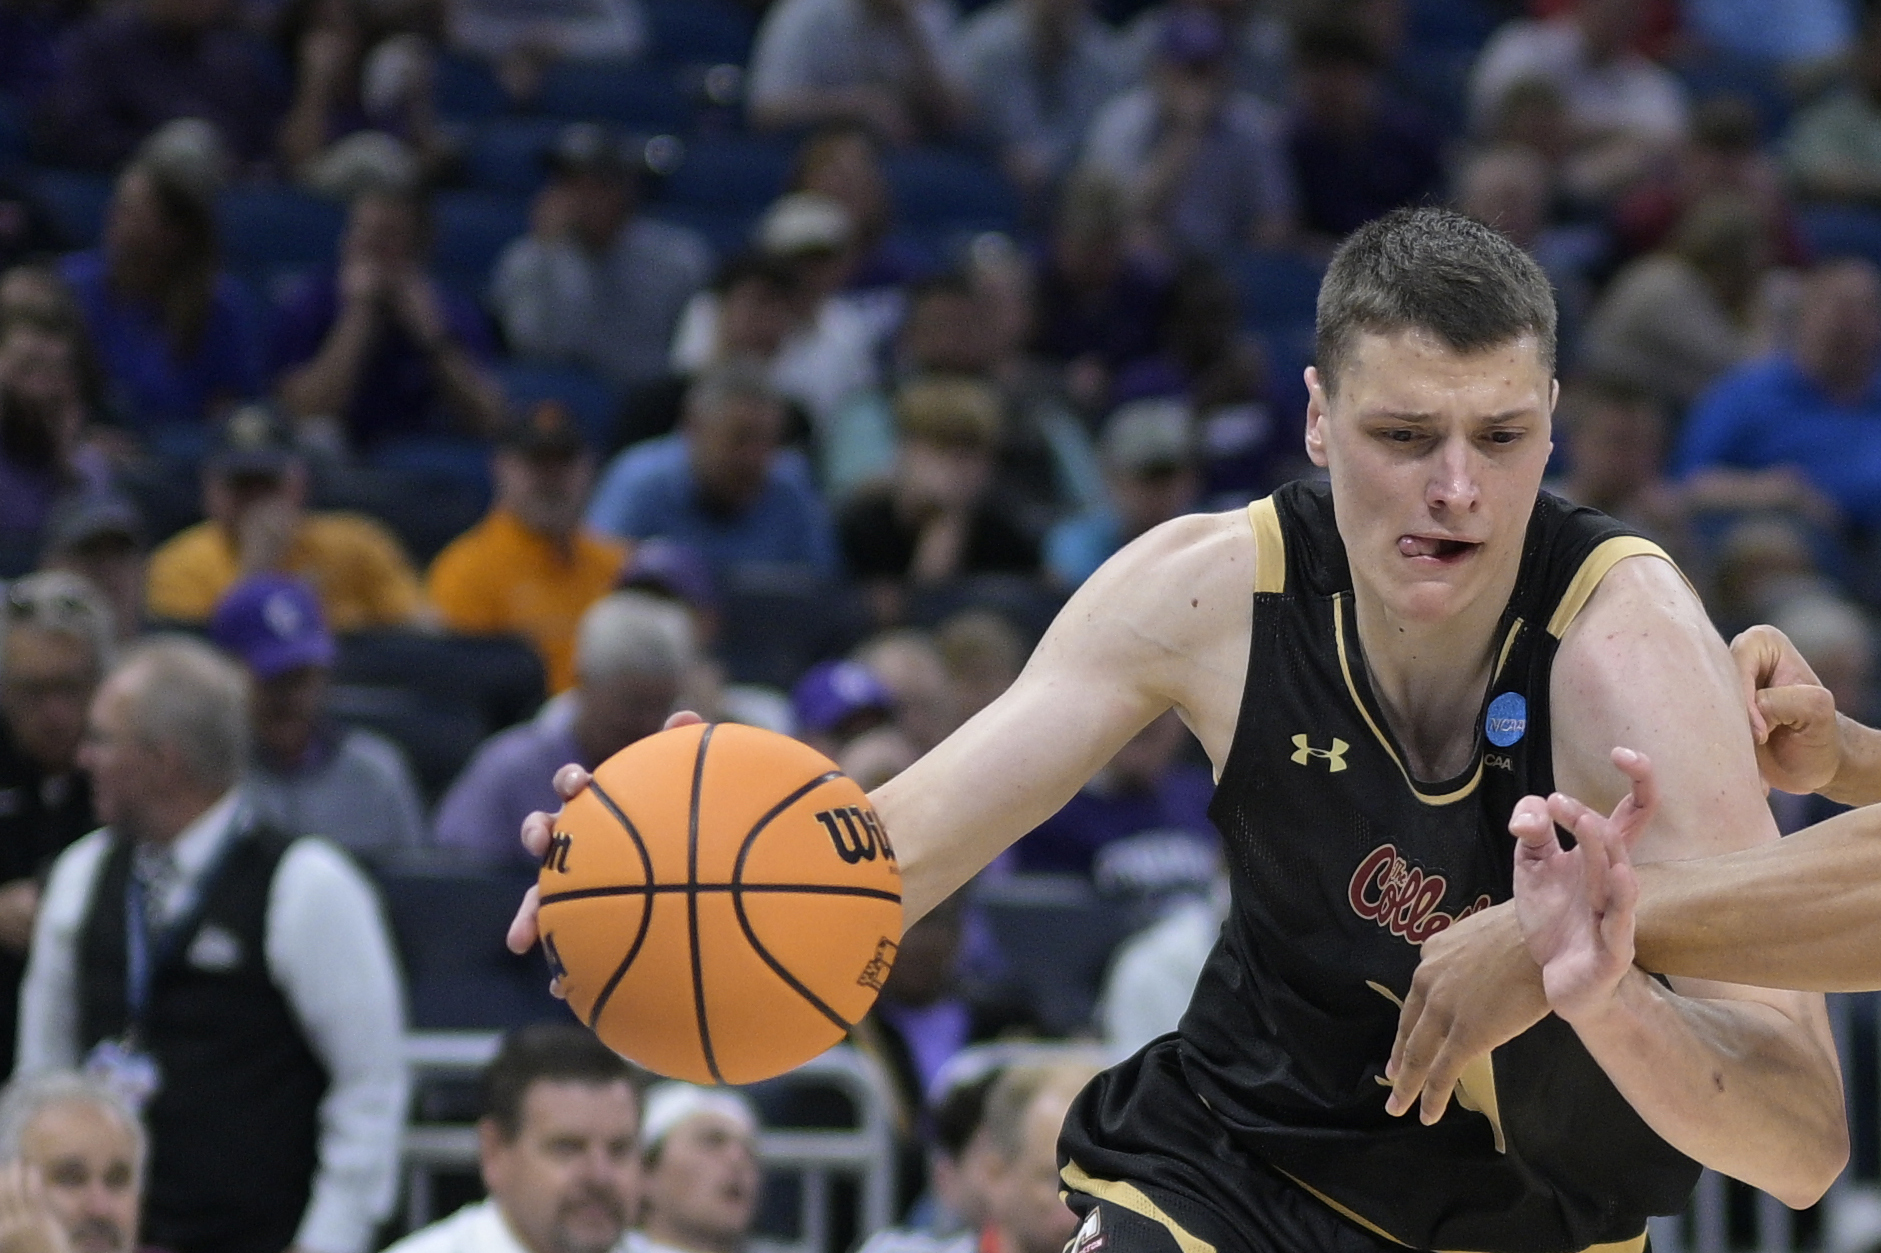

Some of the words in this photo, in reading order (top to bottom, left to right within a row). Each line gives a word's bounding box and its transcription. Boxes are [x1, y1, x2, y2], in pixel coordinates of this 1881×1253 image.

[1489, 717, 1526, 732] NCAA
[1484, 753, 1513, 771] CAA
[1348, 843, 1492, 945] Colle
